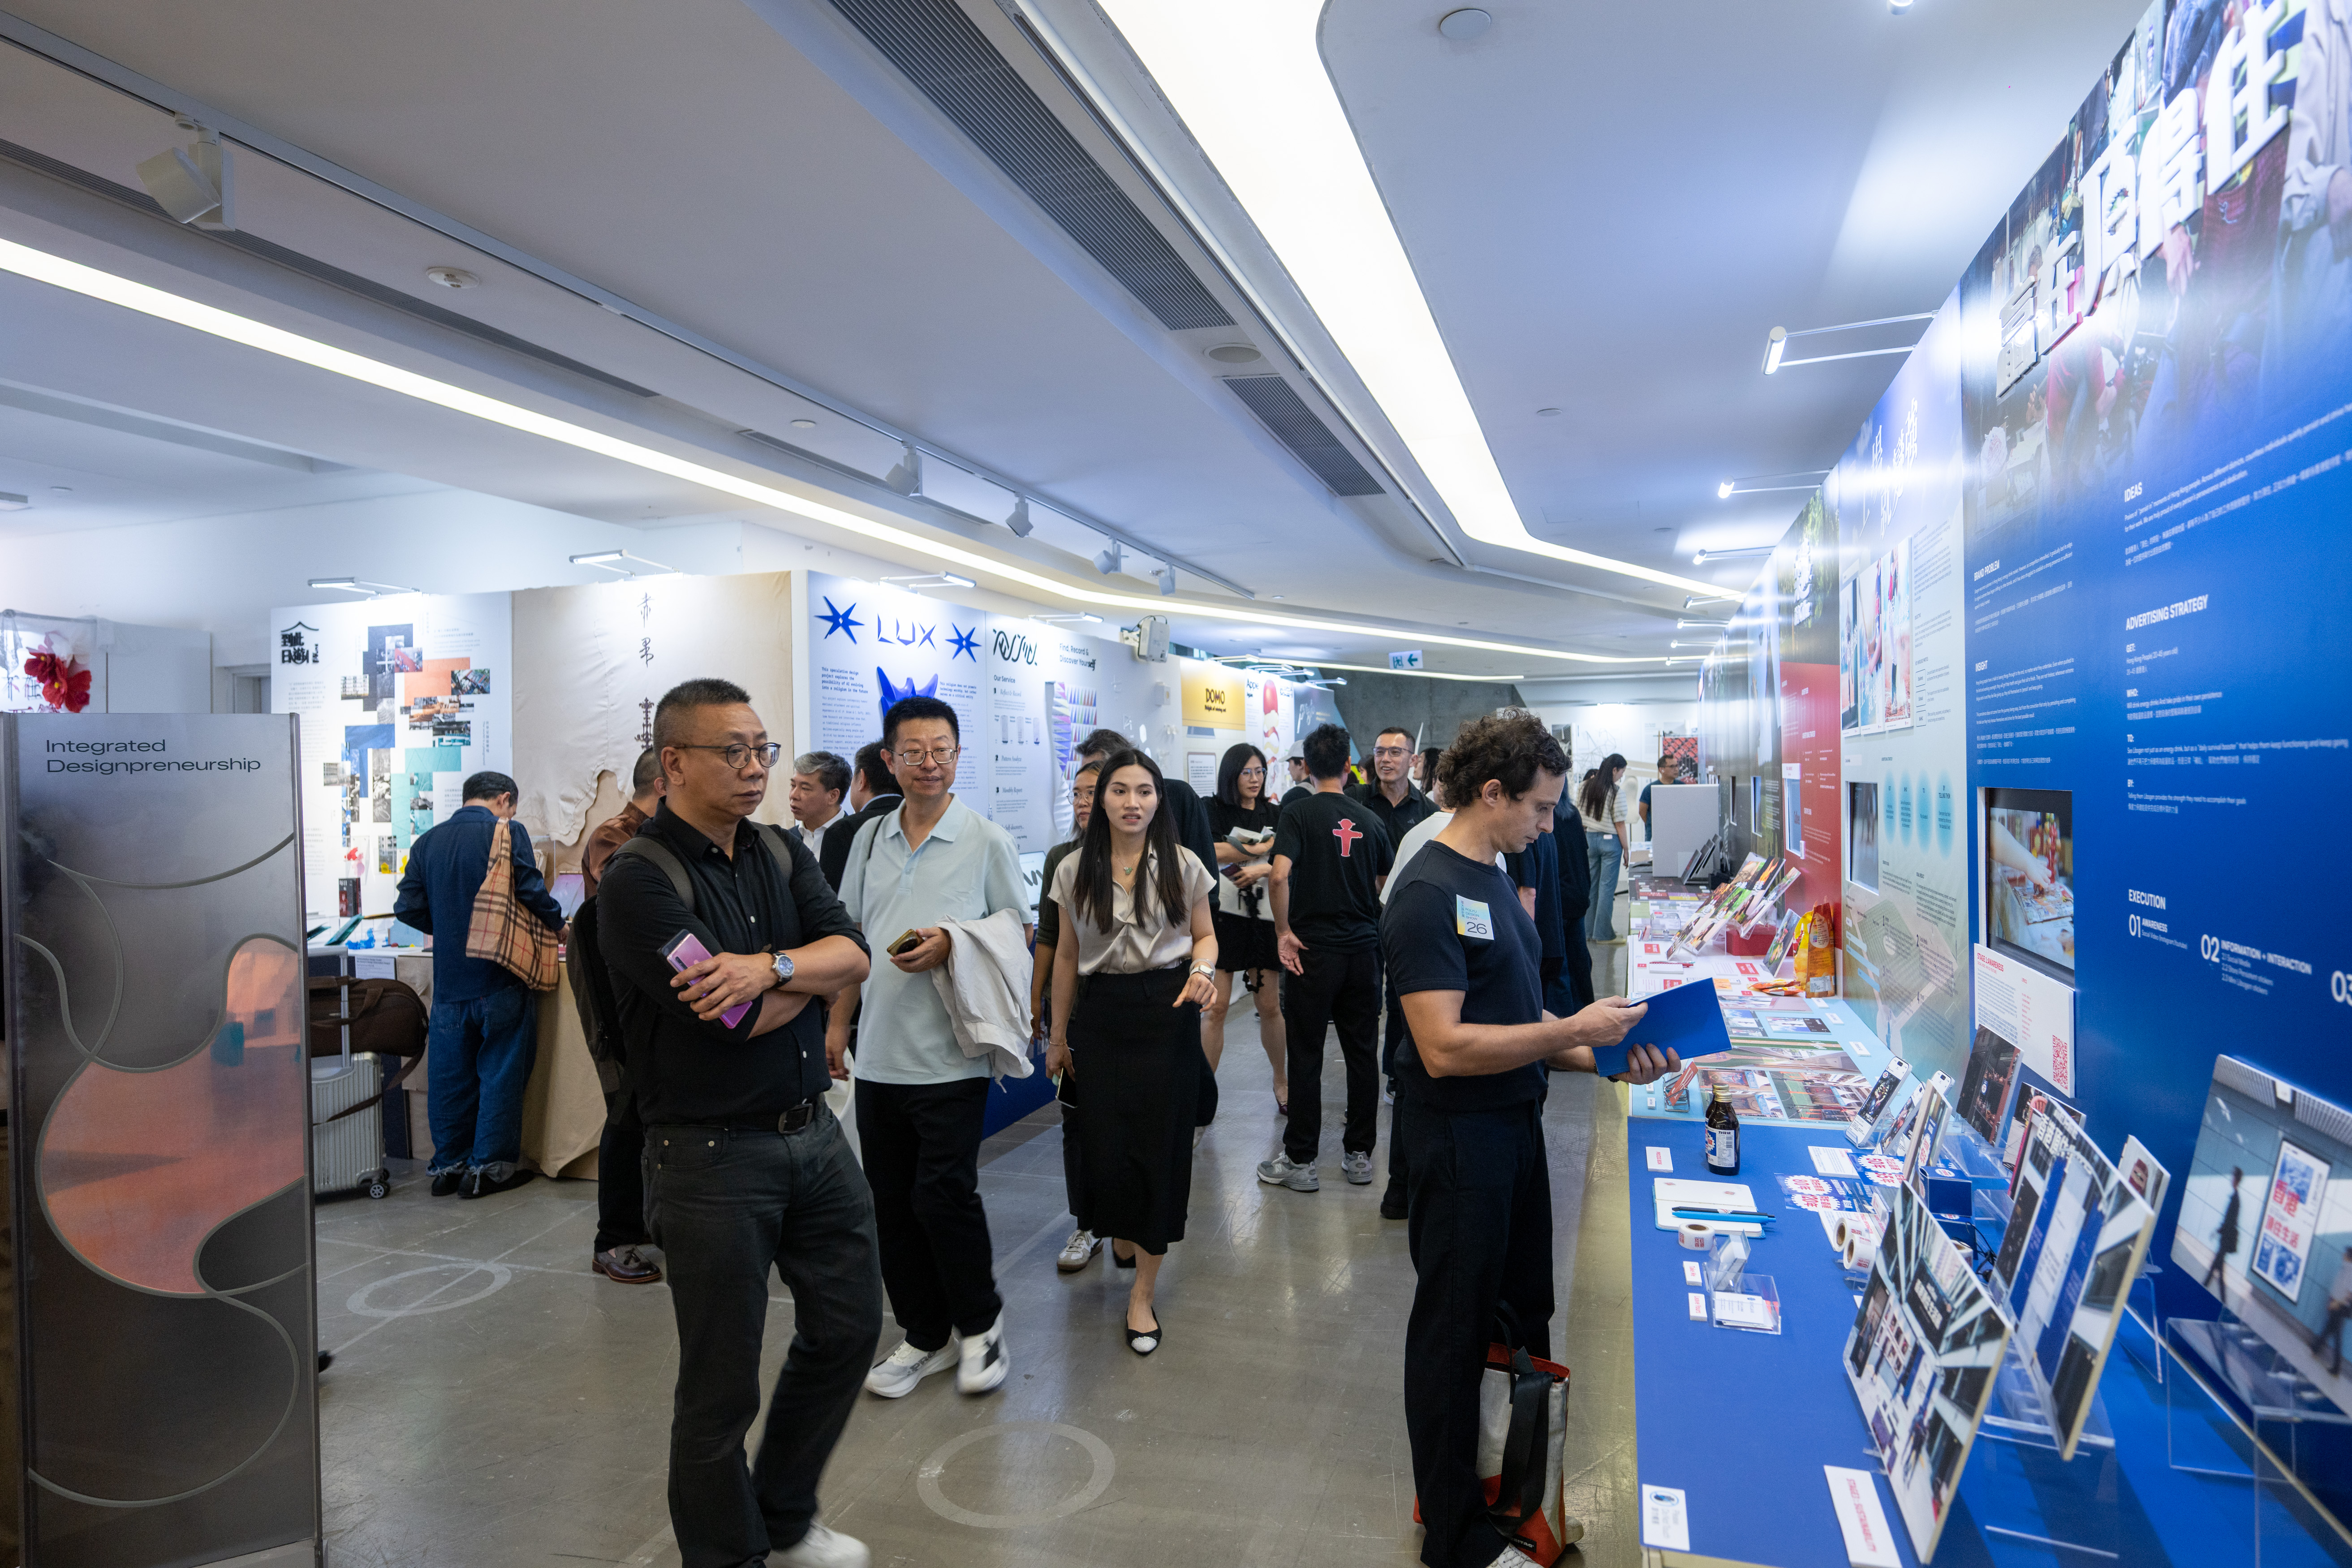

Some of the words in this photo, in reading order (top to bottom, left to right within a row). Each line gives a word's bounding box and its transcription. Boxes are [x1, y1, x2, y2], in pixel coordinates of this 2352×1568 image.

[2124, 482, 2142, 502] IDEAS
[1974, 568, 1984, 581] BRAND
[1985, 560, 1999, 575] PROBLEM
[2126, 607, 2169, 630] ADVERTISING
[2170, 594, 2208, 618] STRATEGY
[878, 613, 937, 652] LUX
[1059, 643, 1070, 653] Find,
[1070, 645, 1085, 655] Record
[2126, 643, 2136, 652] GET:
[1059, 655, 1078, 666] Discover
[1078, 659, 1096, 671] Yourself
[1976, 660, 1988, 672] INSIGHT
[1246, 678, 1259, 690] Apple
[1000, 689, 1009, 697] Reflect
[1206, 688, 1225, 705] DOMO
[2127, 688, 2138, 697] WHO:
[47, 739, 166, 755] Integrated
[47, 758, 261, 775] Designpreneurship
[1012, 755, 1021, 763] Analyze
[1002, 787, 1013, 795] Monthly
[1013, 787, 1022, 795] Report
[2129, 889, 2166, 910] EXECUTION
[1467, 922, 1487, 935] 26
[2129, 914, 2141, 938] 01
[2142, 918, 2167, 932] AWARENESS
[2201, 934, 2220, 963] 02
[2221, 939, 2261, 960] INFORMATION
[2267, 952, 2312, 975] INTERACTION
[1866, 1158, 1886, 1169] 50年
[1792, 1179, 1811, 1190] 80年
[1802, 1194, 1818, 1208] 120年
[2273, 1178, 2300, 1218] 香港
[1854, 1503, 1877, 1553] SUSTAINABILITY
[1512, 1537, 1533, 1547] EITAG
